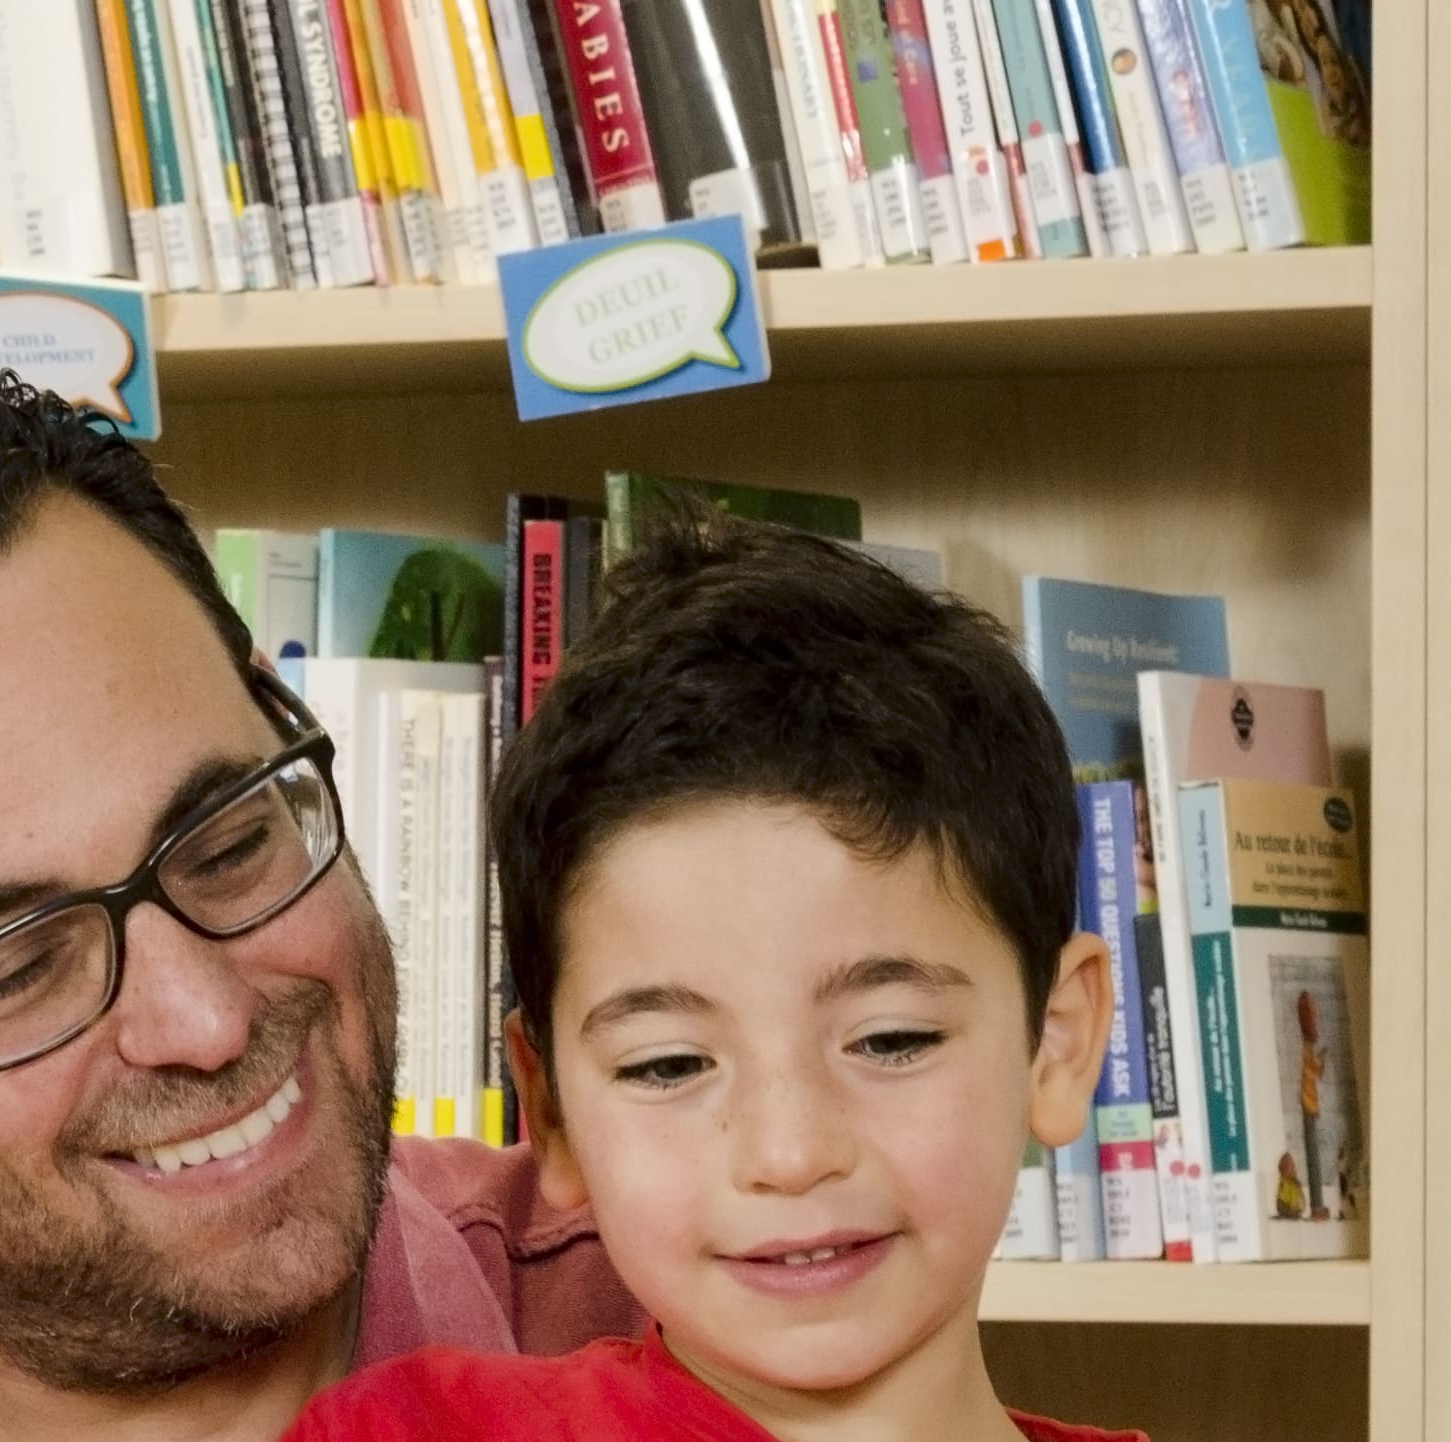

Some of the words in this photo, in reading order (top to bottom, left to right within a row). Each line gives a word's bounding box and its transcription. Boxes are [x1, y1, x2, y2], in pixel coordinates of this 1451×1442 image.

[571, 268, 682, 329] DEUIL
[2, 333, 56, 348] CHILD
[588, 308, 691, 367] GRIEF
[532, 552, 553, 665] BREAKING
[1094, 796, 1115, 836] THE
[1096, 837, 1117, 875] TOP
[1098, 878, 1119, 901] 50
[1108, 1011, 1127, 1048] KIDS
[1112, 1051, 1131, 1097] ASK
